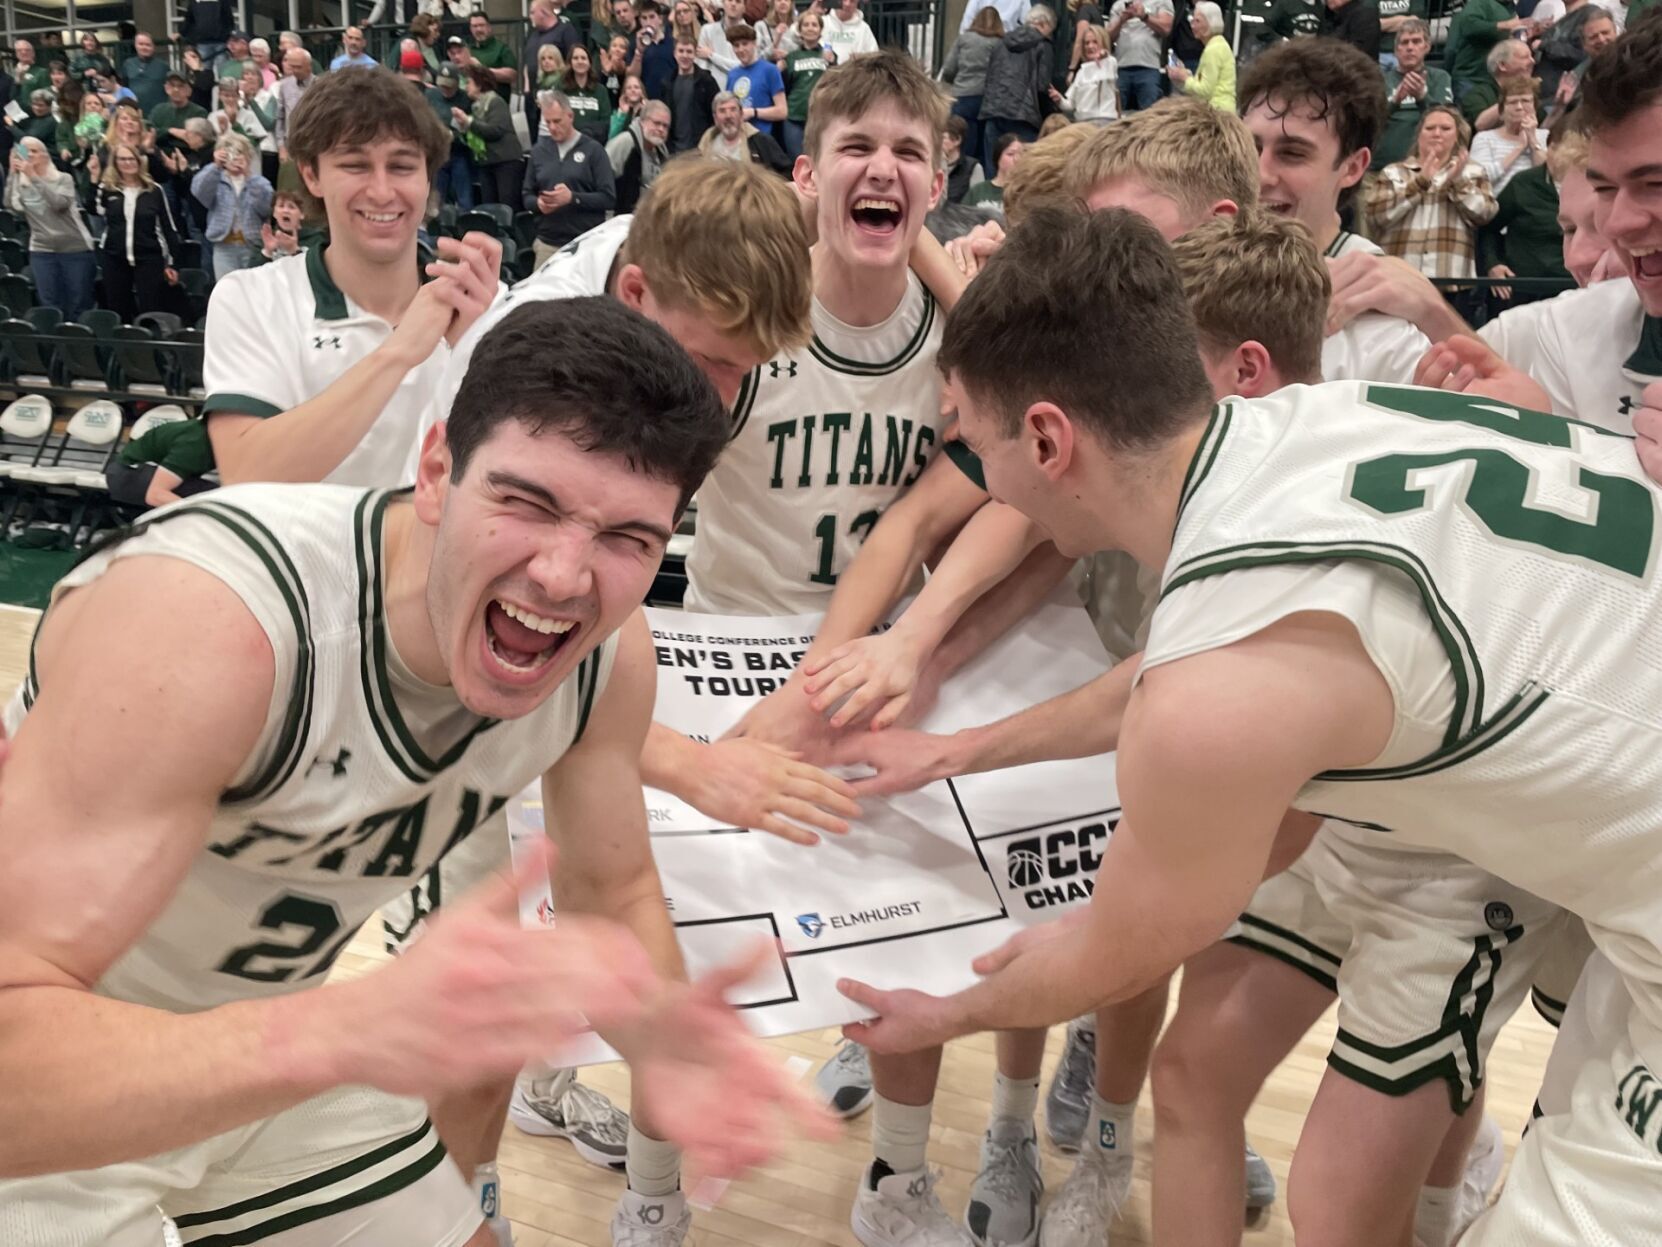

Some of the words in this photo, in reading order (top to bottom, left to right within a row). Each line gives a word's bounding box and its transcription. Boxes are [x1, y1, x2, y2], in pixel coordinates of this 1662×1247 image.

[767, 412, 935, 489] TITANS
[707, 636, 796, 646] CONFERENCE
[684, 675, 787, 697] TOUR
[1046, 818, 1120, 879] CC
[830, 901, 922, 929] ELMHURST
[207, 893, 343, 983] 2
